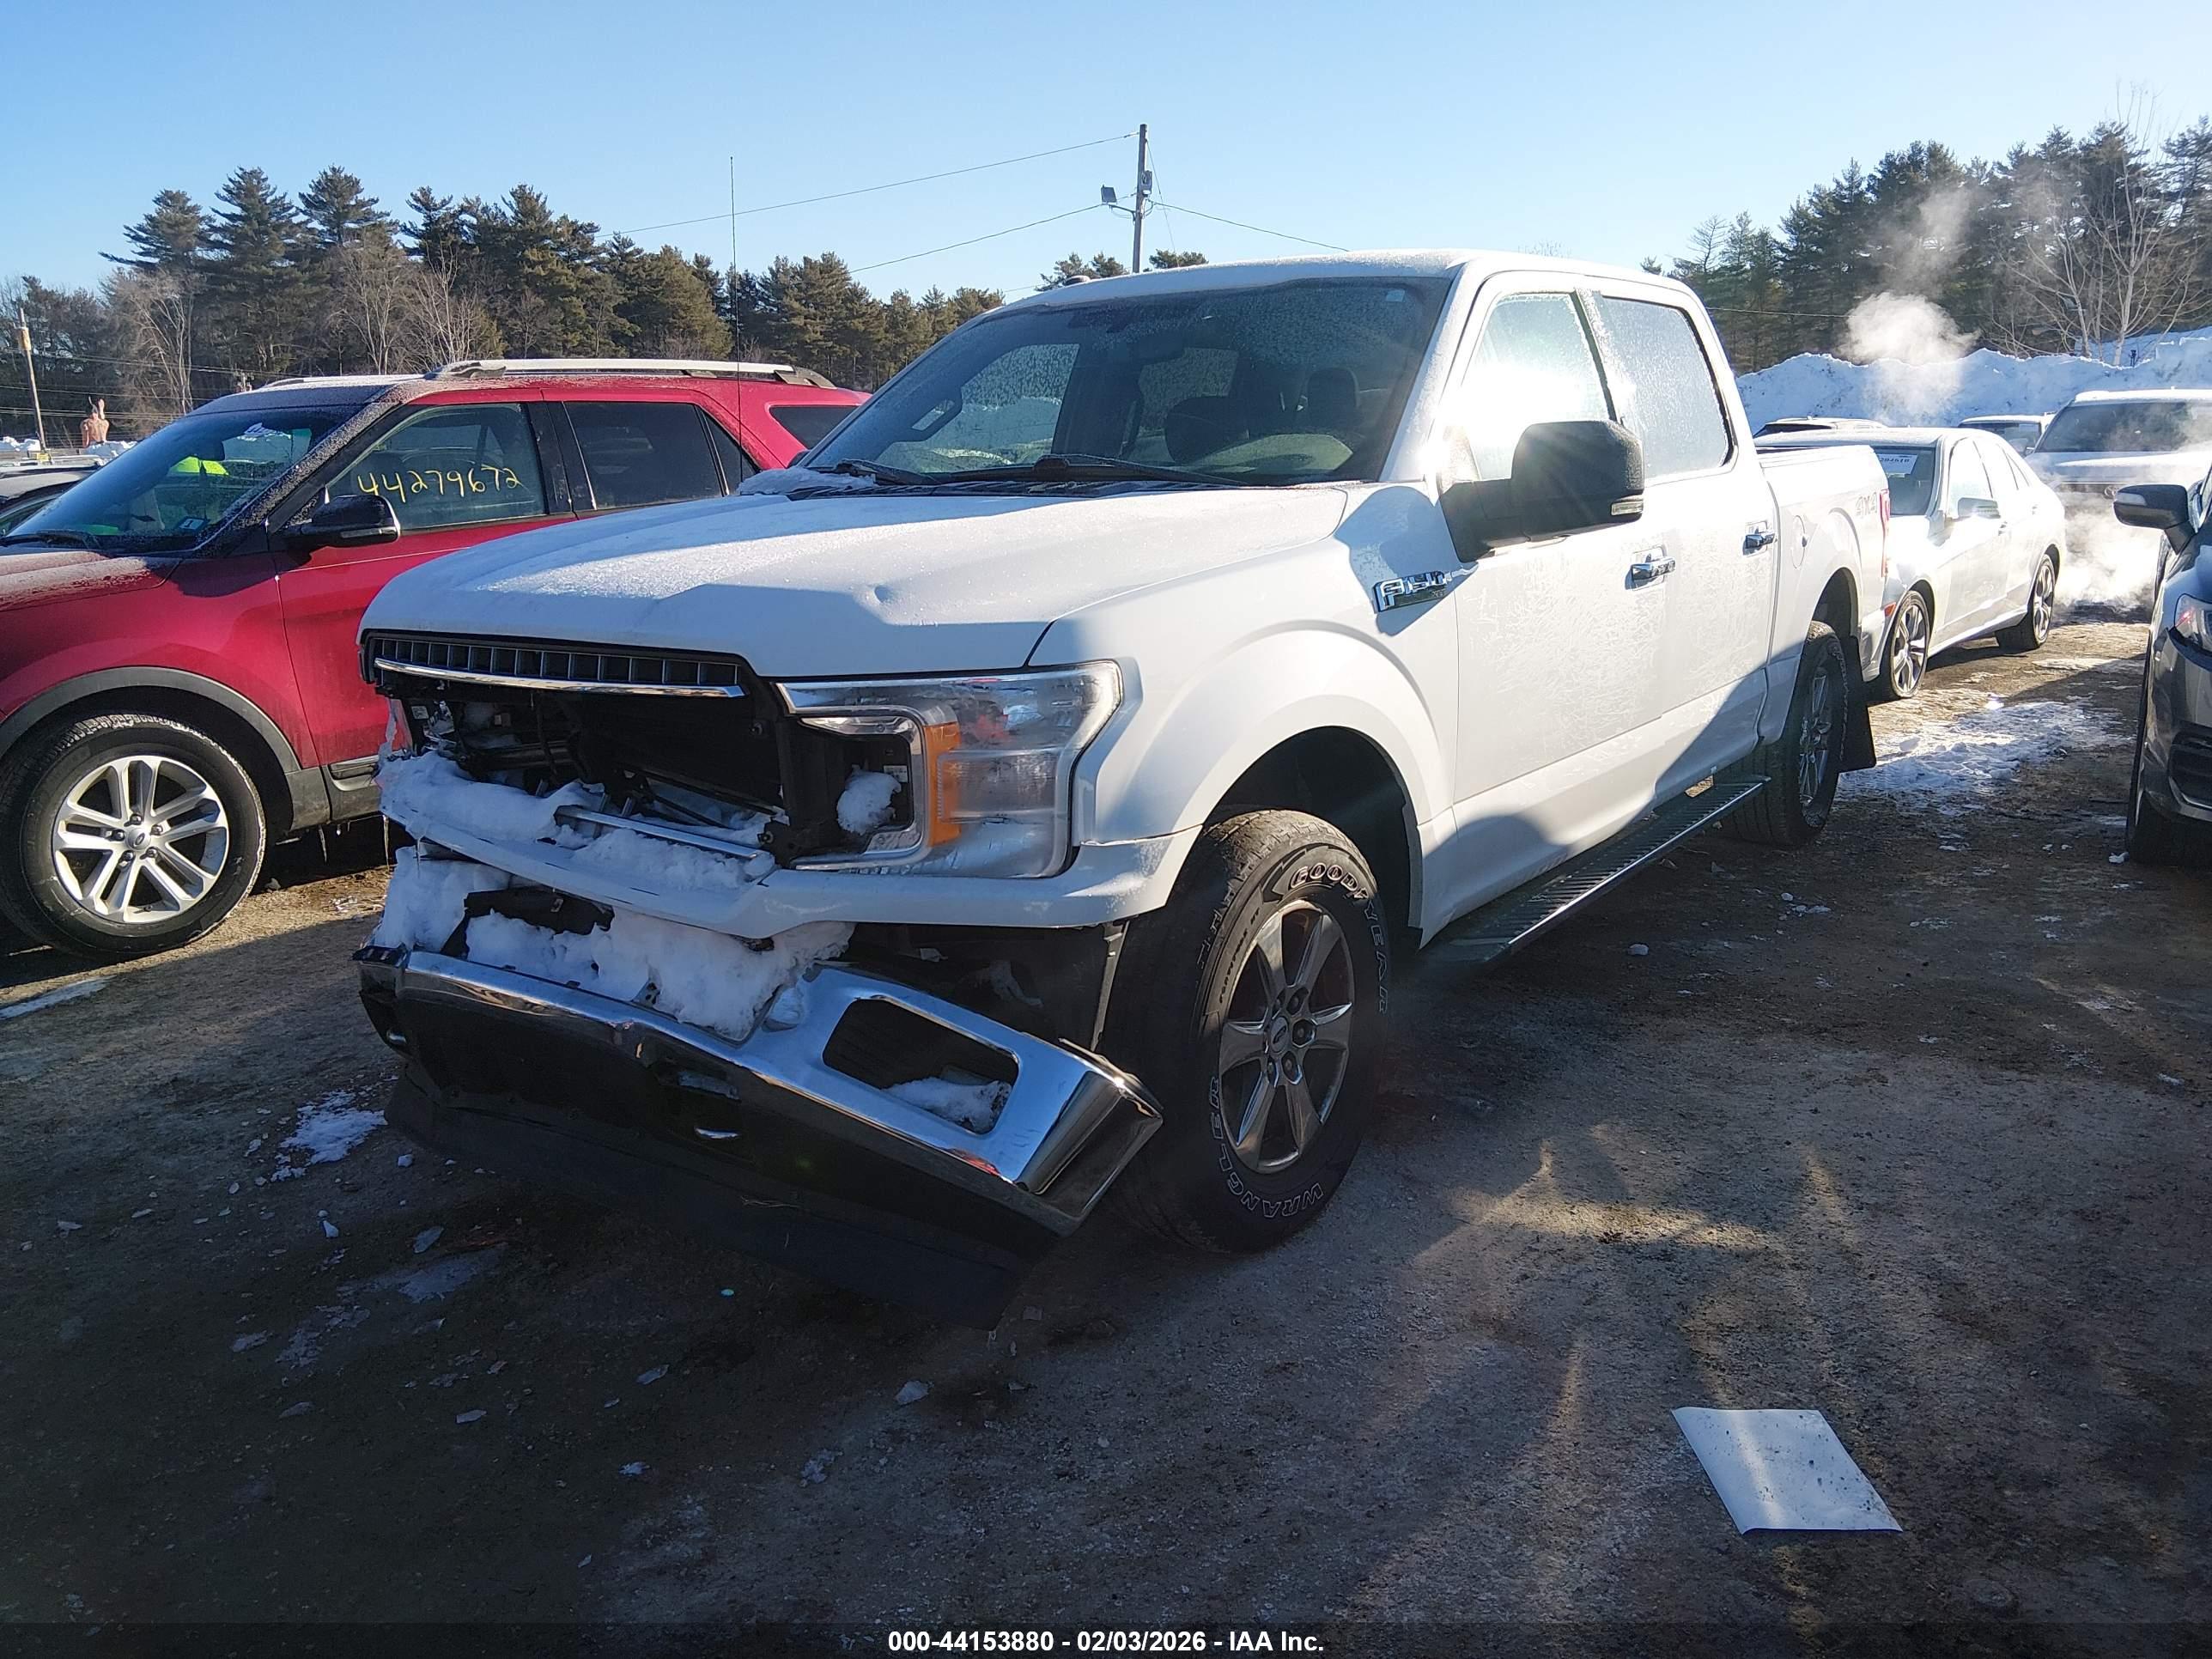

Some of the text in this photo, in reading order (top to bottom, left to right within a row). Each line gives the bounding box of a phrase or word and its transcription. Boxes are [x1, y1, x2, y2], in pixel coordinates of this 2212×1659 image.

[357, 463, 526, 503] 44279672
[1288, 861, 1389, 1016] GOODYEAR
[1208, 1075, 1325, 1218] WRANGLER
